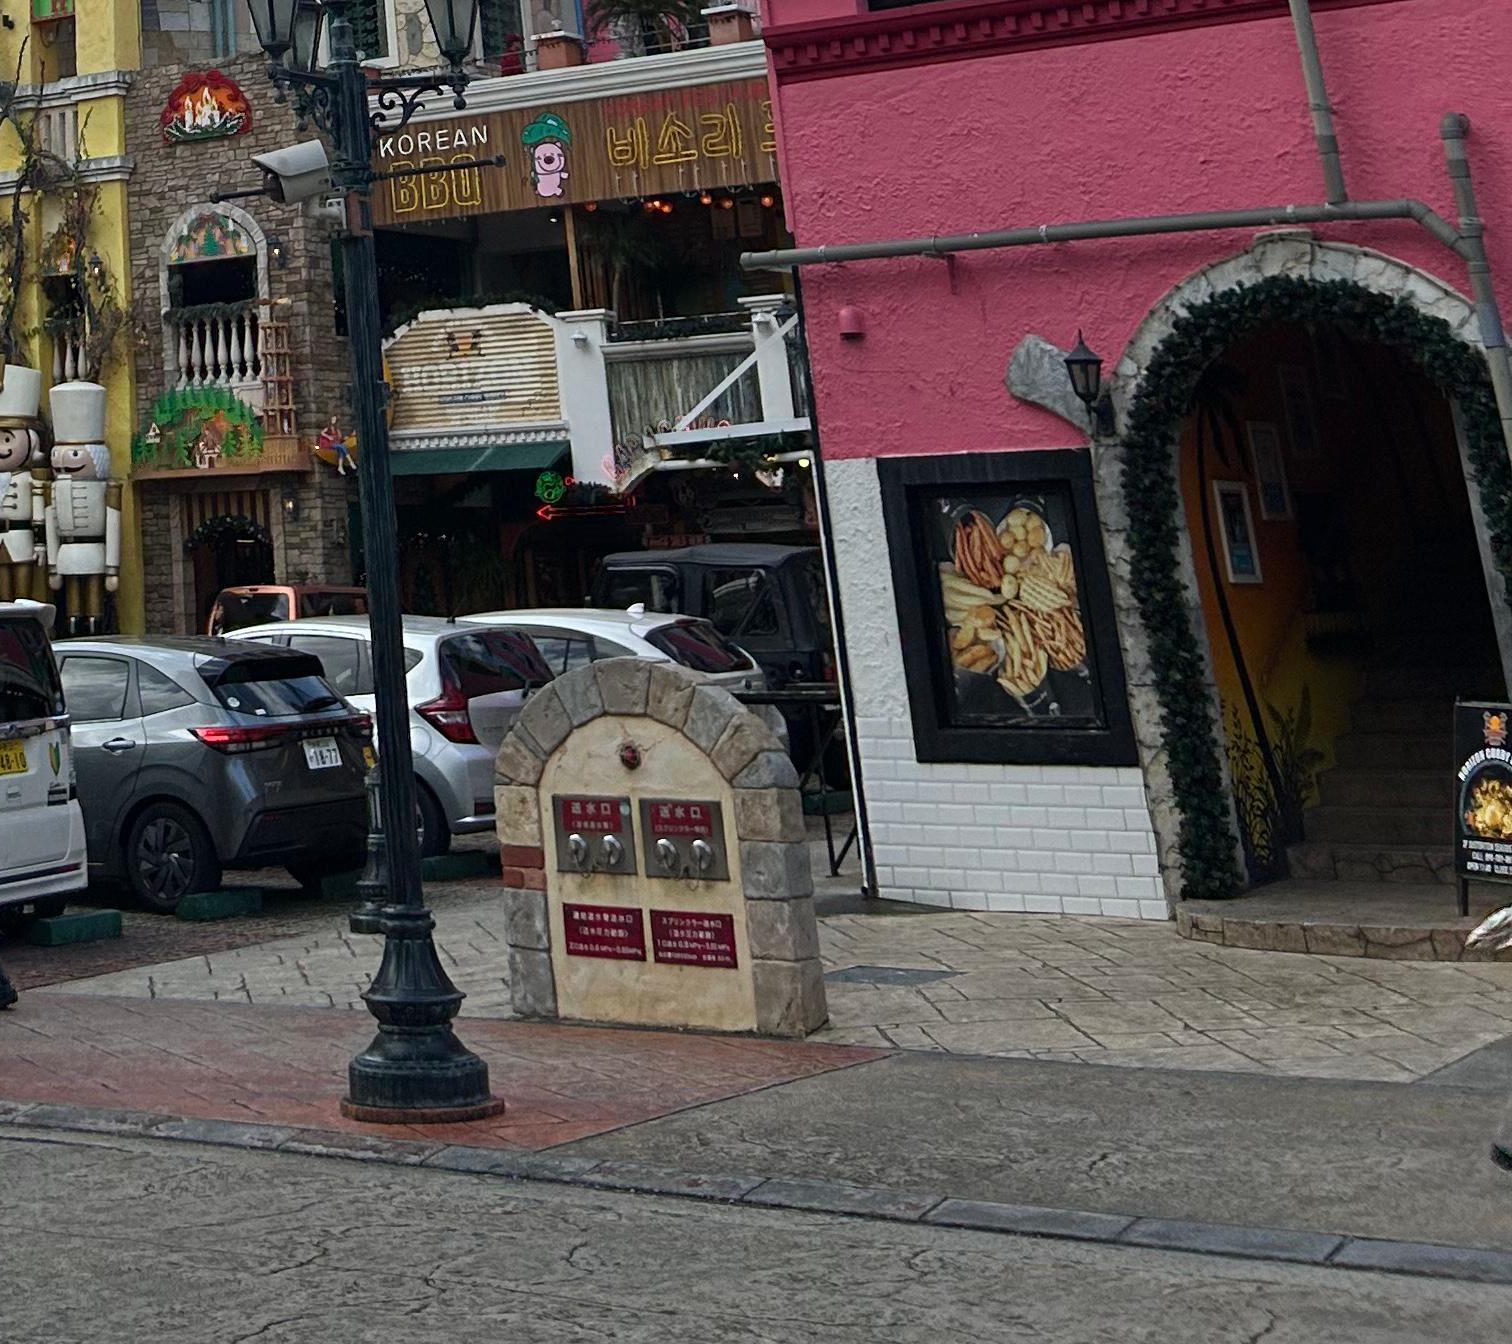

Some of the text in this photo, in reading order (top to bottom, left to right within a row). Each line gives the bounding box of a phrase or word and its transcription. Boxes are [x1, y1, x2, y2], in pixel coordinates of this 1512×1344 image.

[379, 125, 489, 158] KOREAN
[606, 102, 743, 170] 비소리
[390, 153, 482, 213] BBQ
